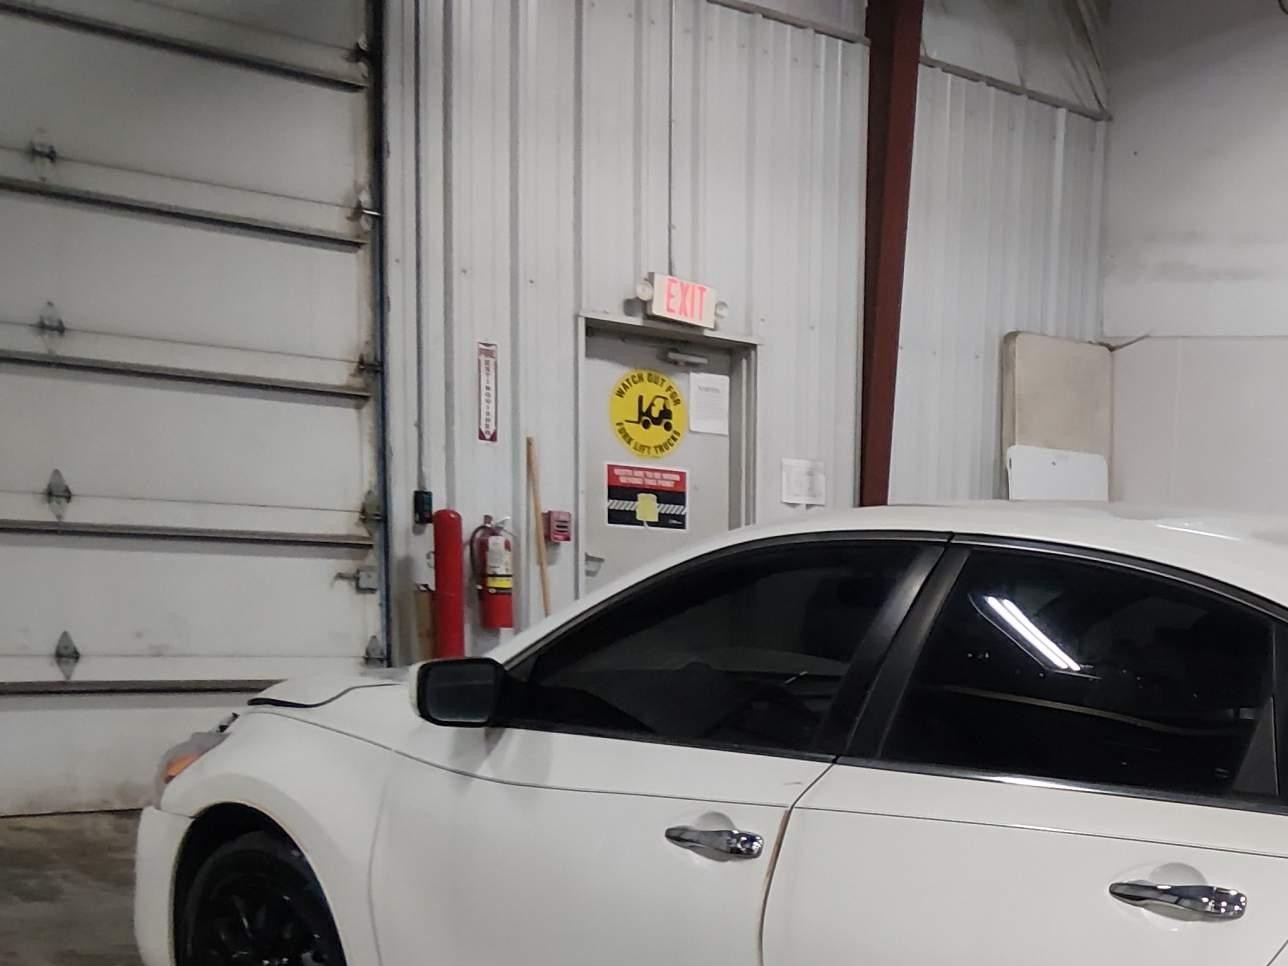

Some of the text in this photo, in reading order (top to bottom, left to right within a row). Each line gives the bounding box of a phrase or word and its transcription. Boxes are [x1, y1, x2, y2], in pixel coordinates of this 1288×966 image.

[666, 277, 707, 320] EXIT
[615, 372, 644, 398] WATCH
[646, 372, 666, 388] OUT
[665, 385, 681, 406] FOR
[633, 443, 652, 455] LIFT
[653, 430, 681, 454] TRUCKS
